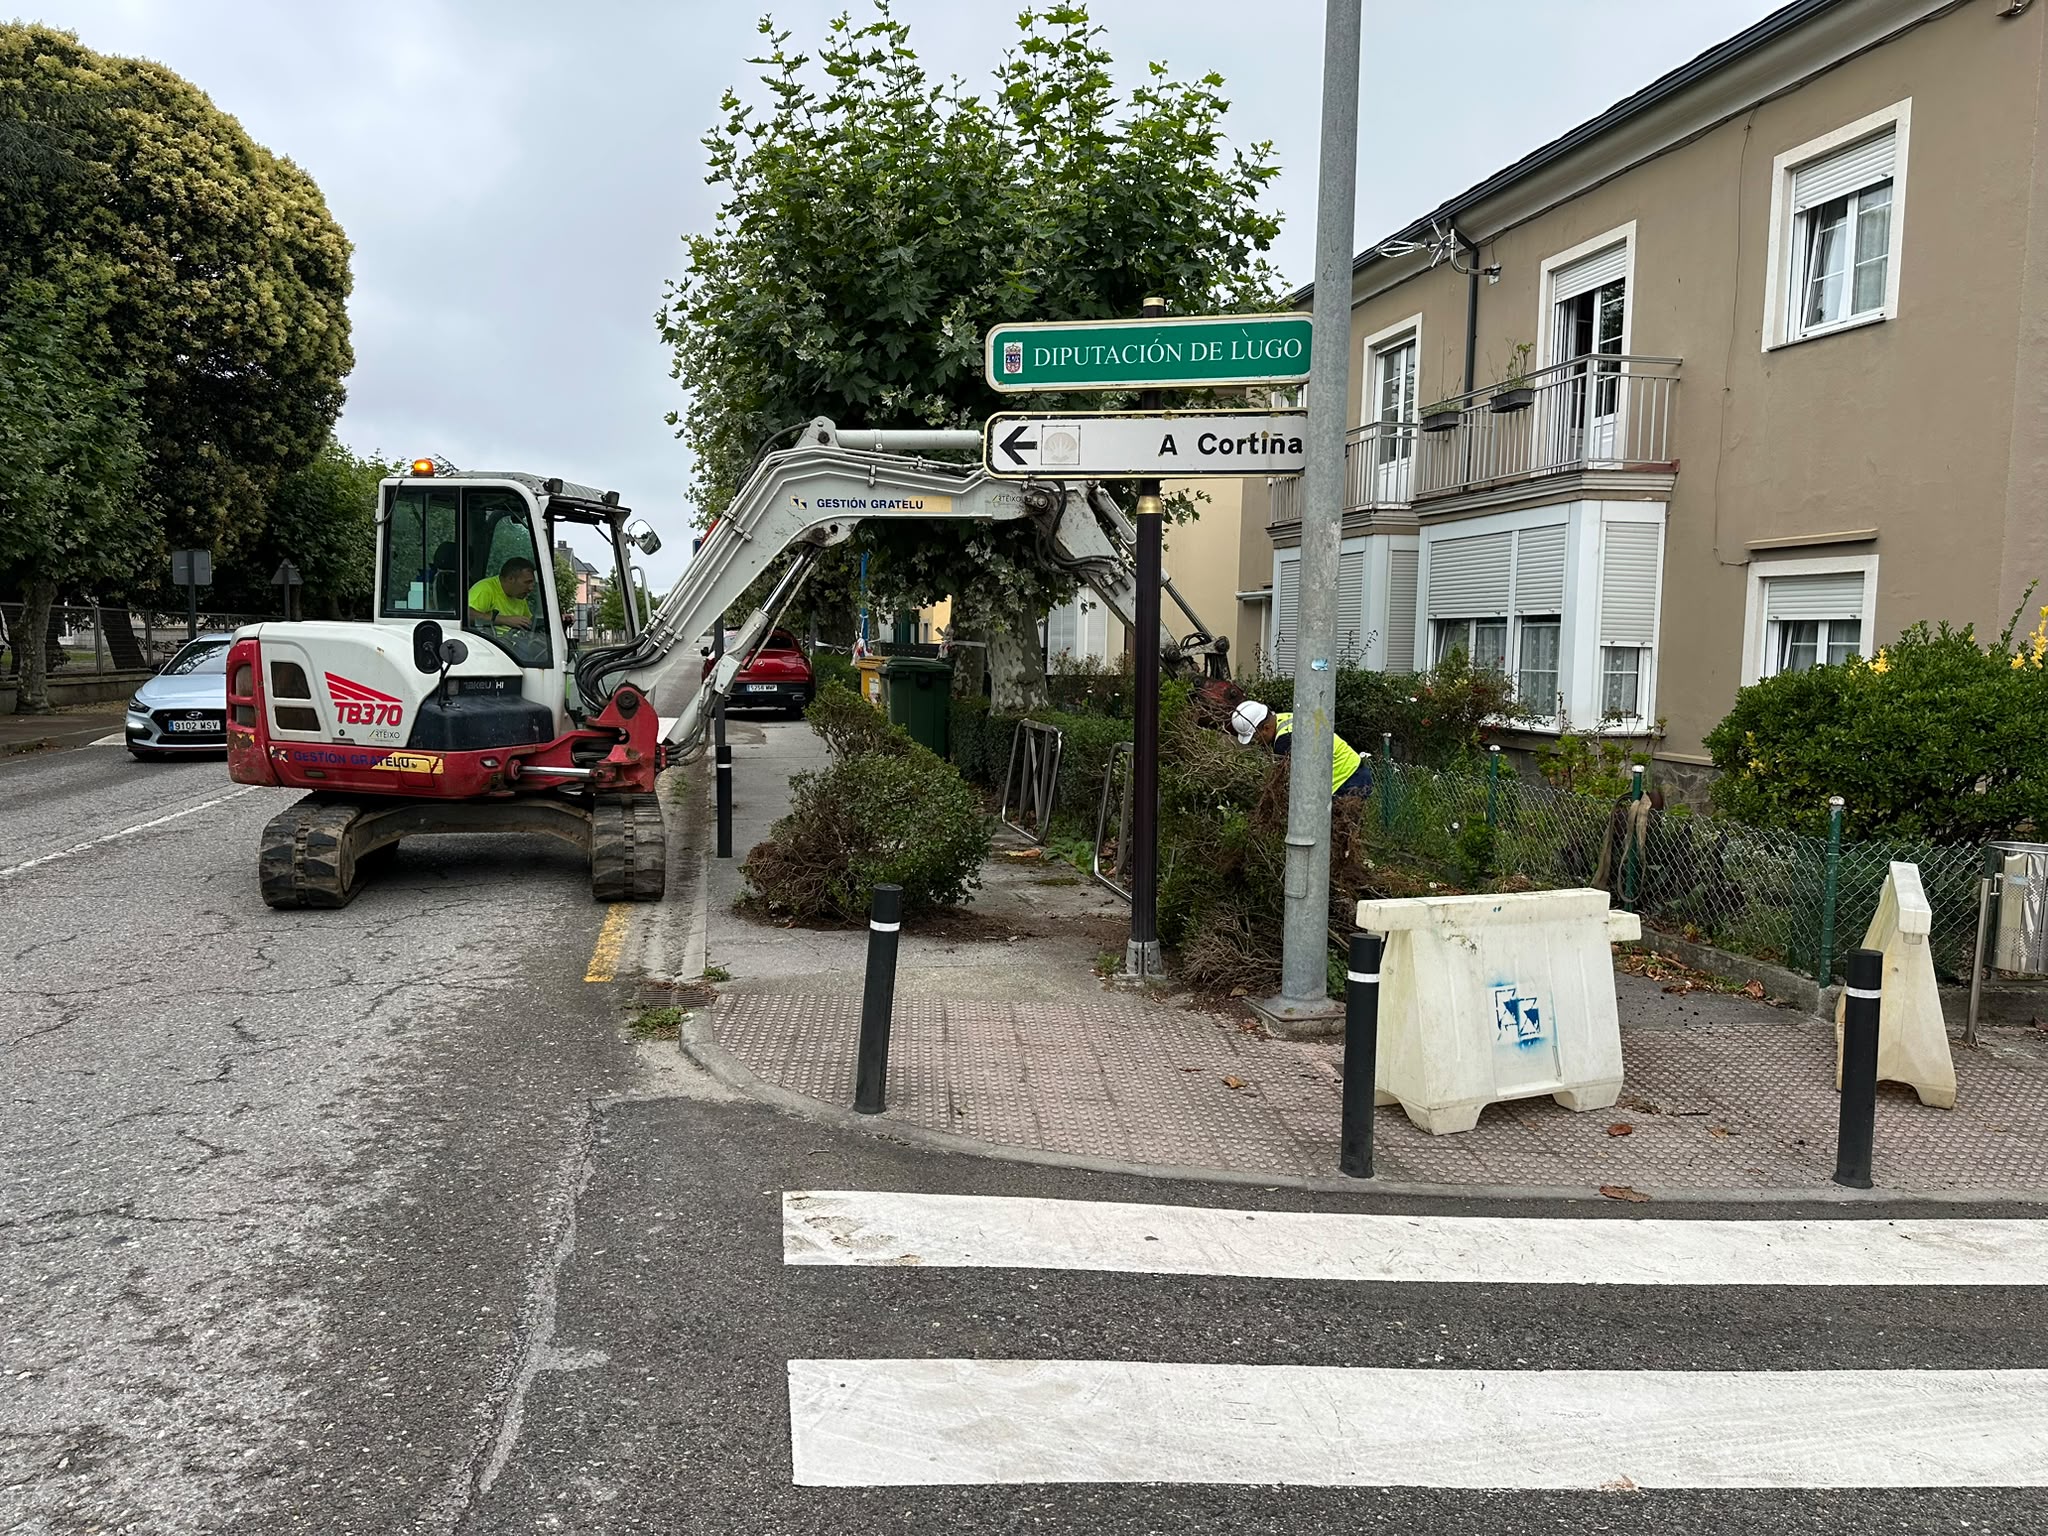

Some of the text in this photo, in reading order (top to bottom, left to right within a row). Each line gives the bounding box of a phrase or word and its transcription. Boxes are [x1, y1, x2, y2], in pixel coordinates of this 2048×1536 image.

[1034, 339, 1182, 367] DIPUTACIÓN
[1190, 341, 1223, 361] DE
[1158, 434, 1178, 456] A
[817, 497, 923, 510] GESTIÓN GRATELU
[334, 702, 403, 726] TB370
[175, 721, 197, 730] 9102
[351, 754, 409, 768] GRATELU
